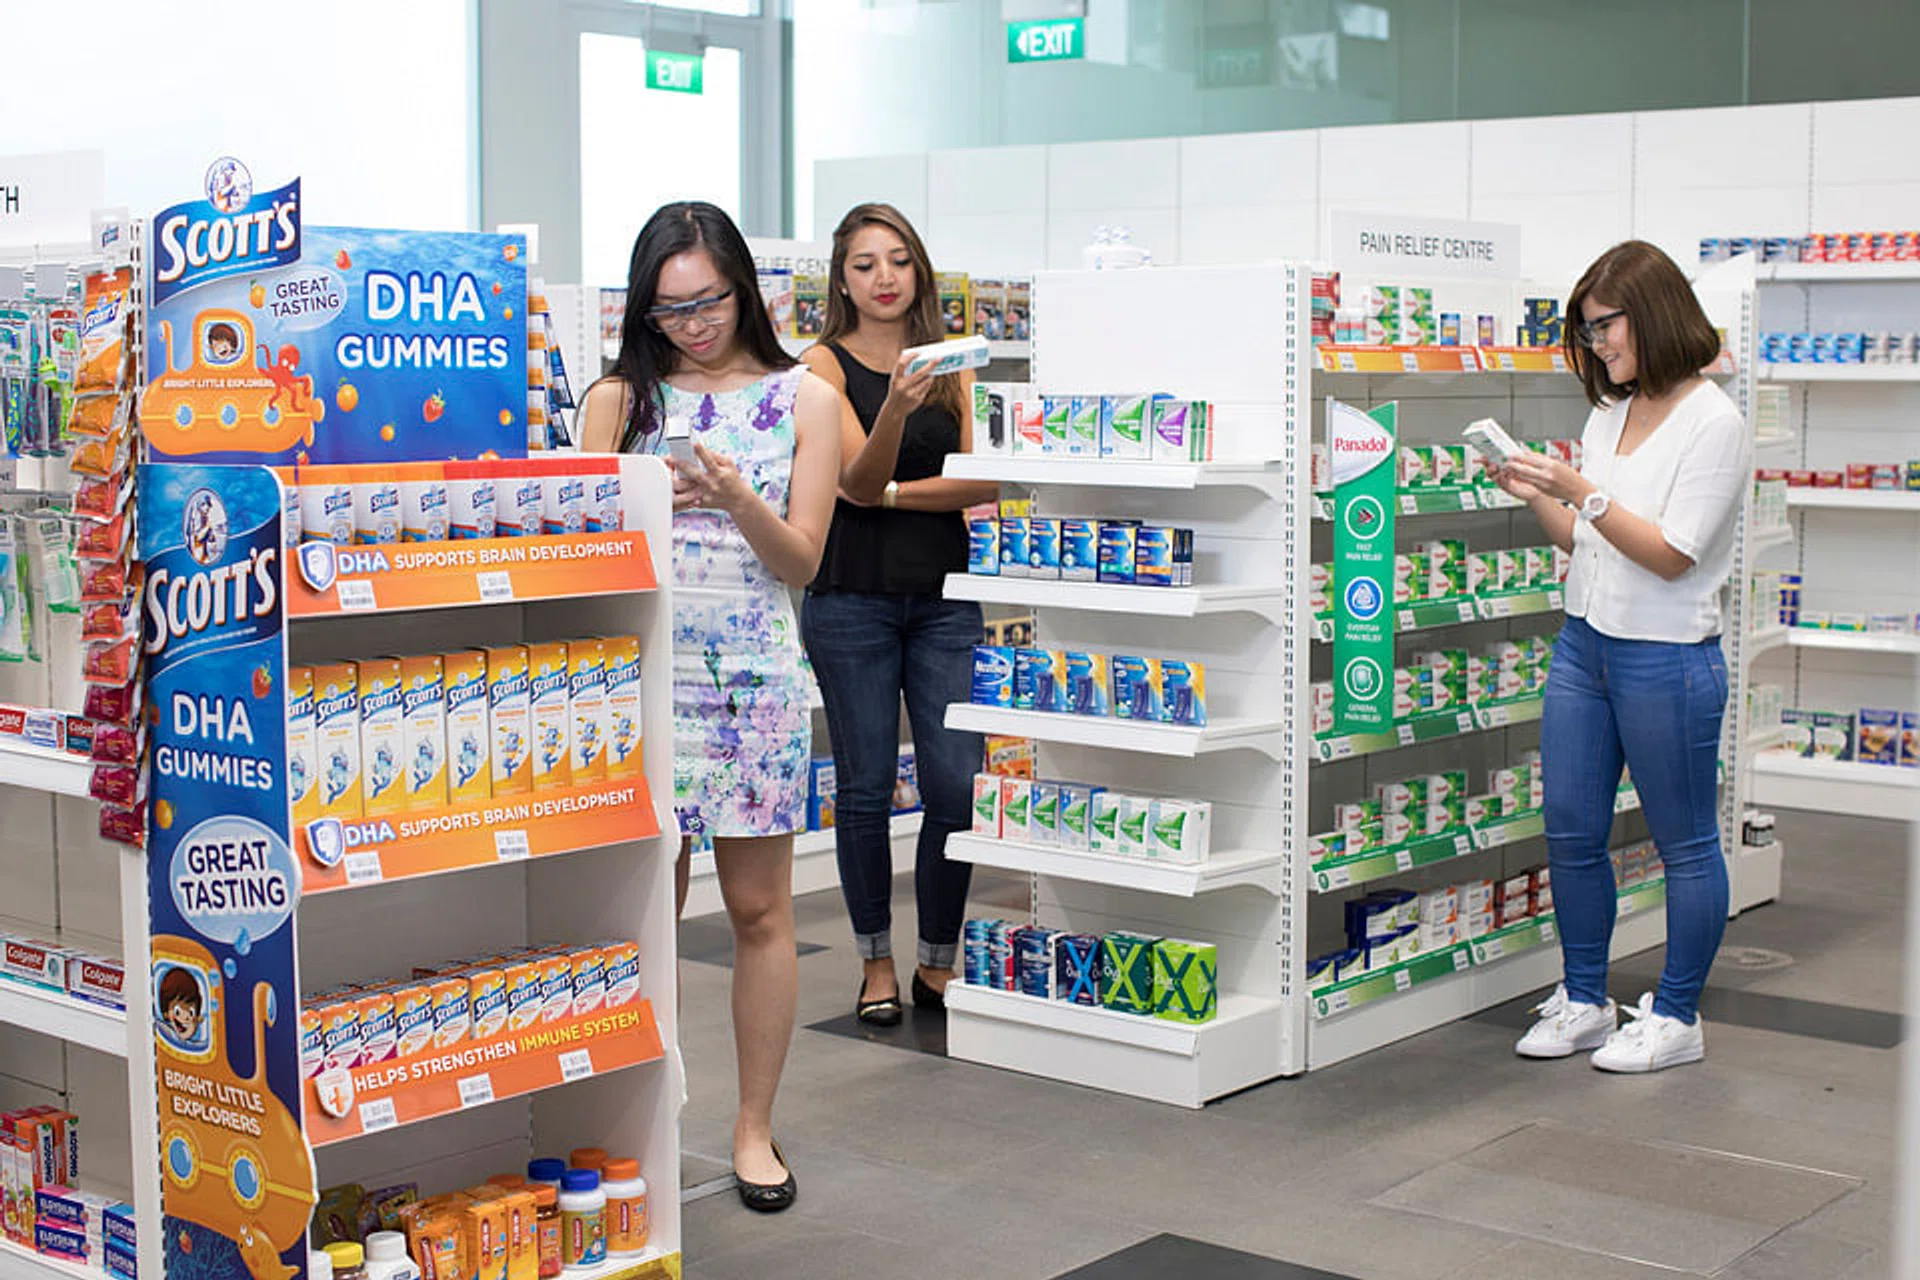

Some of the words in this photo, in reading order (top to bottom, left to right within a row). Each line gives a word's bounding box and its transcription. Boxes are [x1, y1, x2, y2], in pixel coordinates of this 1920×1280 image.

[1030, 24, 1075, 57] EXIT
[656, 59, 692, 88] EXIT
[159, 200, 297, 281] SCOTT'S
[1360, 232, 1392, 253] PAIN
[1395, 235, 1439, 256] RELIEF
[1443, 240, 1494, 261] CENTRE
[275, 276, 330, 299] GREAT
[365, 271, 488, 322] DHA
[269, 294, 340, 318] TASTING
[336, 335, 509, 370] GUMMIES
[1334, 437, 1387, 452] Panadol
[338, 550, 390, 575] DHA
[395, 550, 476, 569] SUPPORTS
[480, 547, 526, 564] BRAIN
[530, 541, 633, 561] DEVELOPMENT
[147, 547, 276, 657] SCOTT'S
[172, 694, 254, 747] DHA
[156, 745, 274, 792] GUMMIES
[345, 820, 396, 847] DHA
[400, 812, 480, 837] SUPPORTS
[484, 805, 529, 824] BRAIN
[534, 788, 635, 816] DEVELOPMENT
[186, 838, 268, 874] GREAT
[180, 875, 286, 911] TASTING
[354, 1066, 408, 1092] HELPS
[412, 1040, 517, 1078] STRENGTHEN
[520, 1025, 581, 1052] IMMUNE
[584, 1011, 640, 1037] SYSTEM
[164, 1068, 216, 1098] BRIGHT
[217, 1084, 264, 1115] LITTLE
[173, 1096, 262, 1137] EXPLORERS
